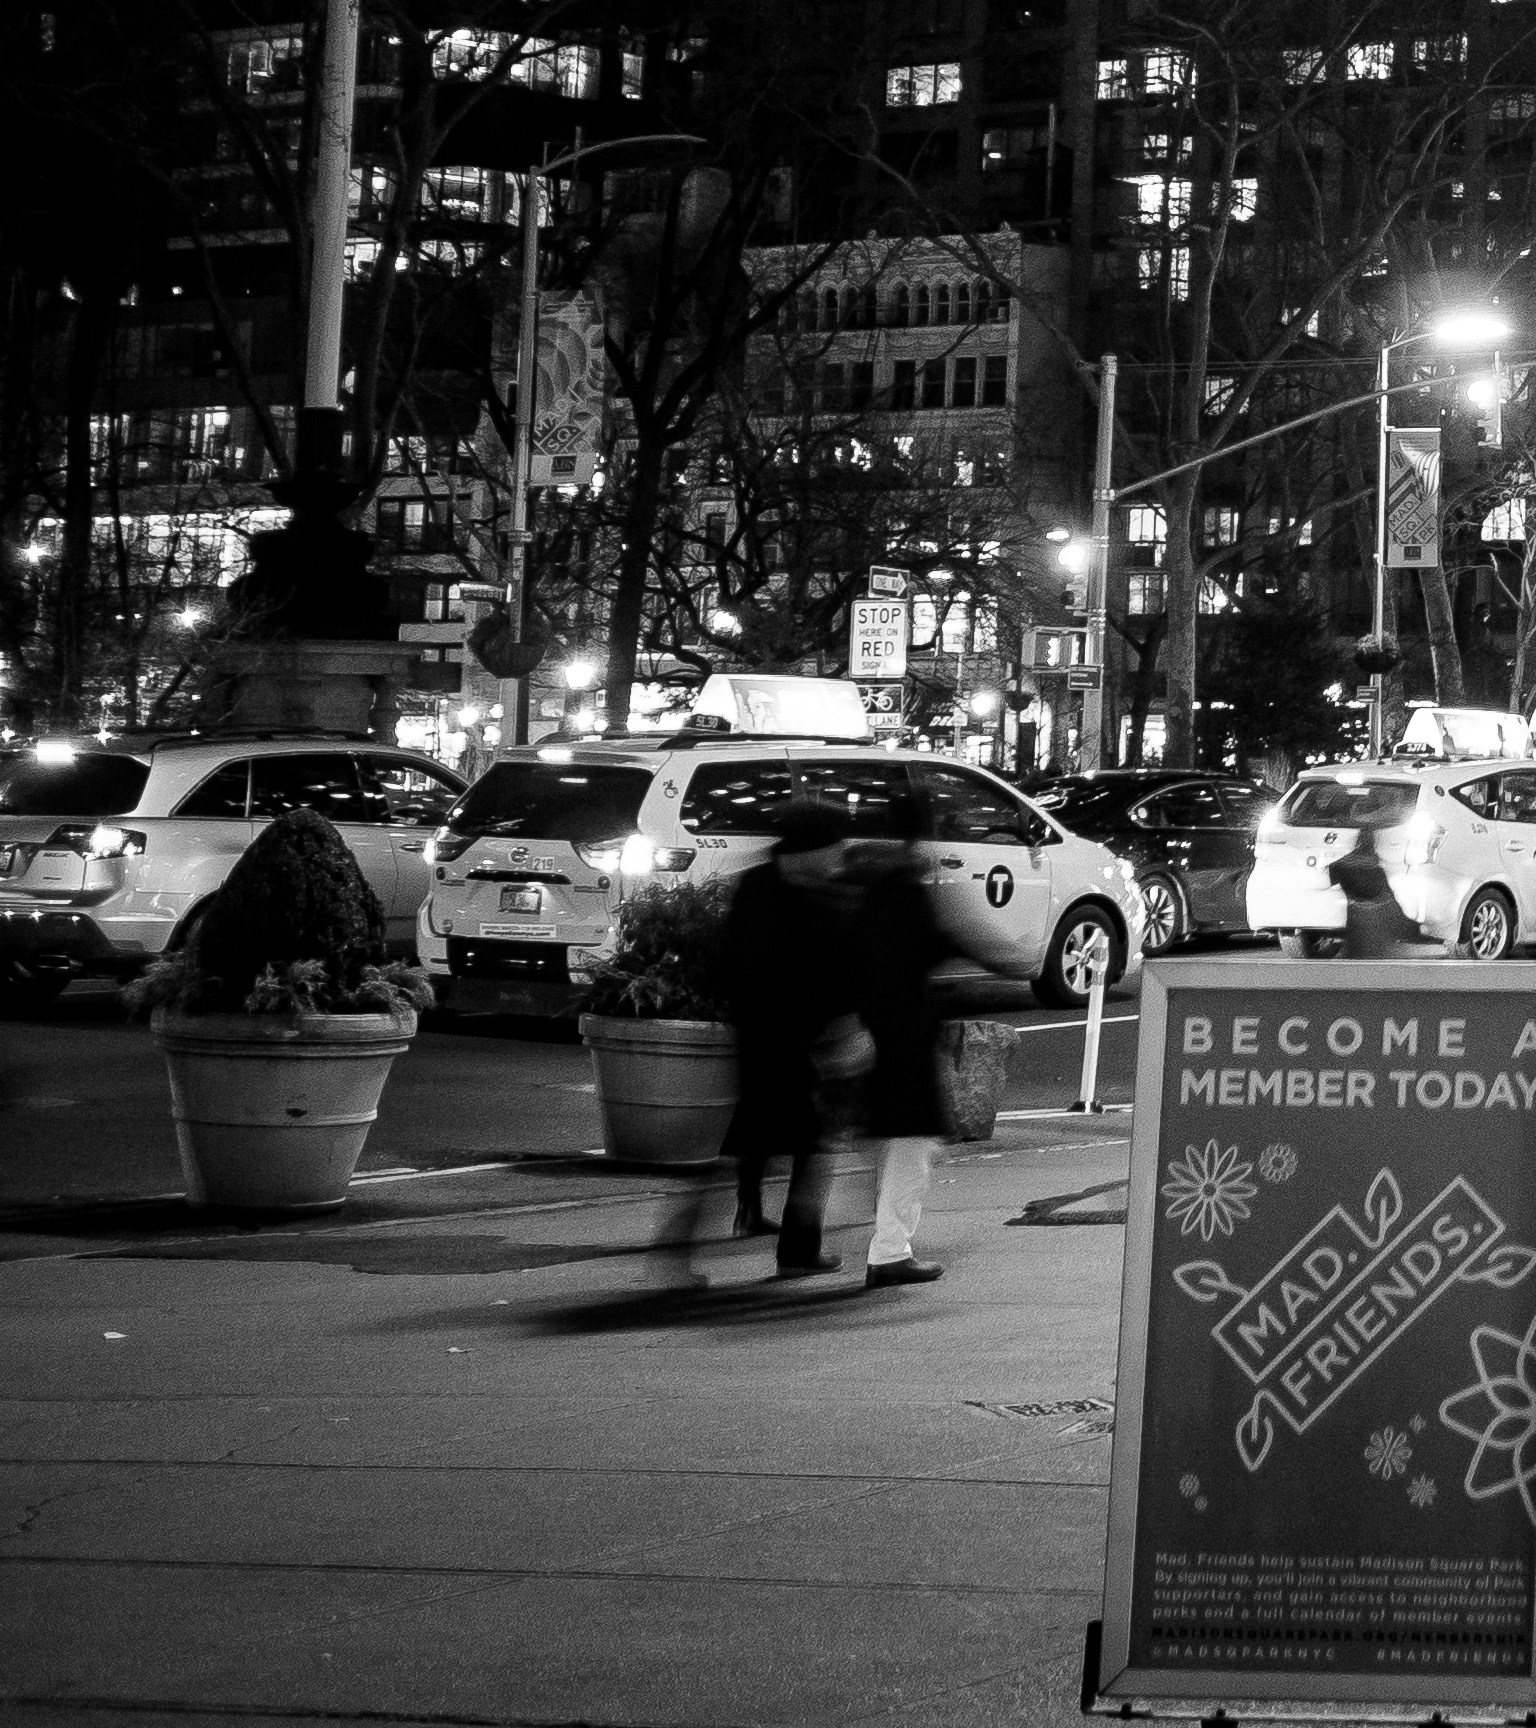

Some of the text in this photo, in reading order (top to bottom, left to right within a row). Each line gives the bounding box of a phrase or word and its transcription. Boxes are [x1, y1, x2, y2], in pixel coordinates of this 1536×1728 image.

[858, 607, 901, 624] STOP
[859, 627, 898, 637] HERE ON
[861, 641, 894, 657] RED
[860, 660, 888, 670] SIGNA
[992, 873, 1009, 903] T
[1182, 1016, 1467, 1058] BECOME
[1180, 1068, 1377, 1108] MEMBER
[1237, 1246, 1359, 1357] MAD.
[1280, 1213, 1483, 1407] FRIENDS.
[1198, 1552, 1256, 1569] Friends
[1260, 1554, 1294, 1570] help
[1299, 1556, 1355, 1570] sustain
[1359, 1556, 1425, 1571] Madison
[1430, 1557, 1485, 1573] Square
[1489, 1558, 1524, 1572] Park
[1154, 1570, 1173, 1586] By
[1177, 1571, 1228, 1587] signing
[1297, 1573, 1324, 1588] join
[1327, 1575, 1337, 1585] a
[1340, 1575, 1389, 1588] vibrant
[1393, 1576, 1471, 1590] community
[1474, 1576, 1490, 1589] of
[1493, 1576, 1525, 1590] Park
[1252, 1590, 1284, 1603] and
[1288, 1591, 1324, 1606] gain
[1330, 1593, 1384, 1605] access
[1389, 1593, 1407, 1606] to
[1412, 1594, 1528, 1608] neighborhood
[1152, 1605, 1198, 1620] parks
[1204, 1605, 1235, 1619] and
[1240, 1608, 1250, 1619] a
[1256, 1606, 1284, 1619] full
[1369, 1608, 1386, 1623] of
[1392, 1610, 1459, 1623] member
